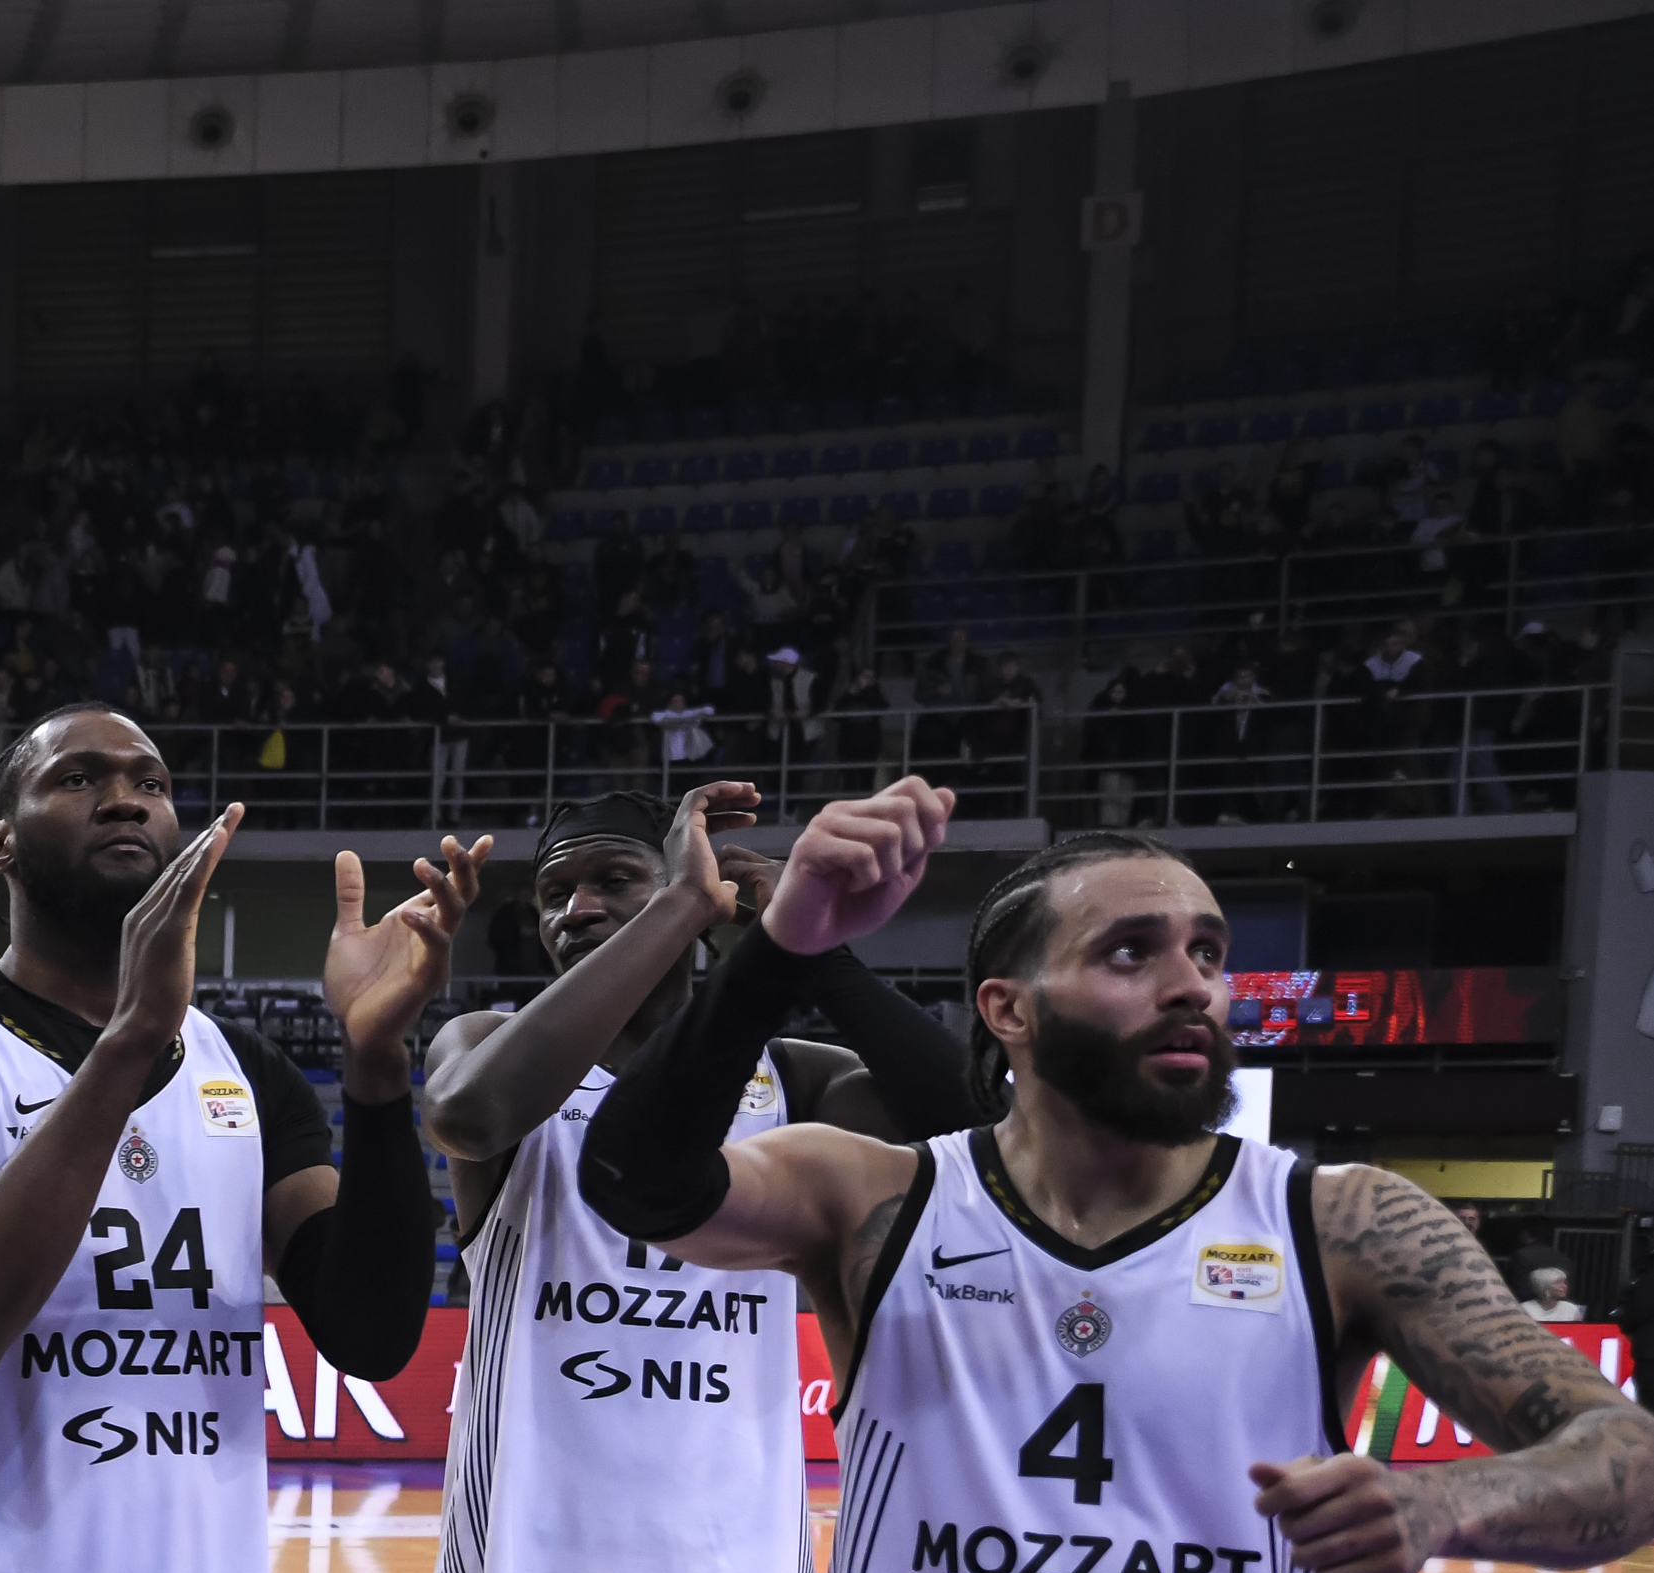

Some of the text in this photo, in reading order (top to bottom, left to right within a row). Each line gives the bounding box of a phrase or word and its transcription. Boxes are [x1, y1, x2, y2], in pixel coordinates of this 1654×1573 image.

[89, 1207, 214, 1311] 24
[1206, 1249, 1275, 1262] MOZZART
[533, 1280, 768, 1336] MOZZART
[20, 1329, 263, 1380] MOZZART
[263, 1321, 406, 1439] AK
[640, 1358, 731, 1404] NIS
[145, 1411, 221, 1456] NIS
[1016, 1382, 1115, 1506] 4
